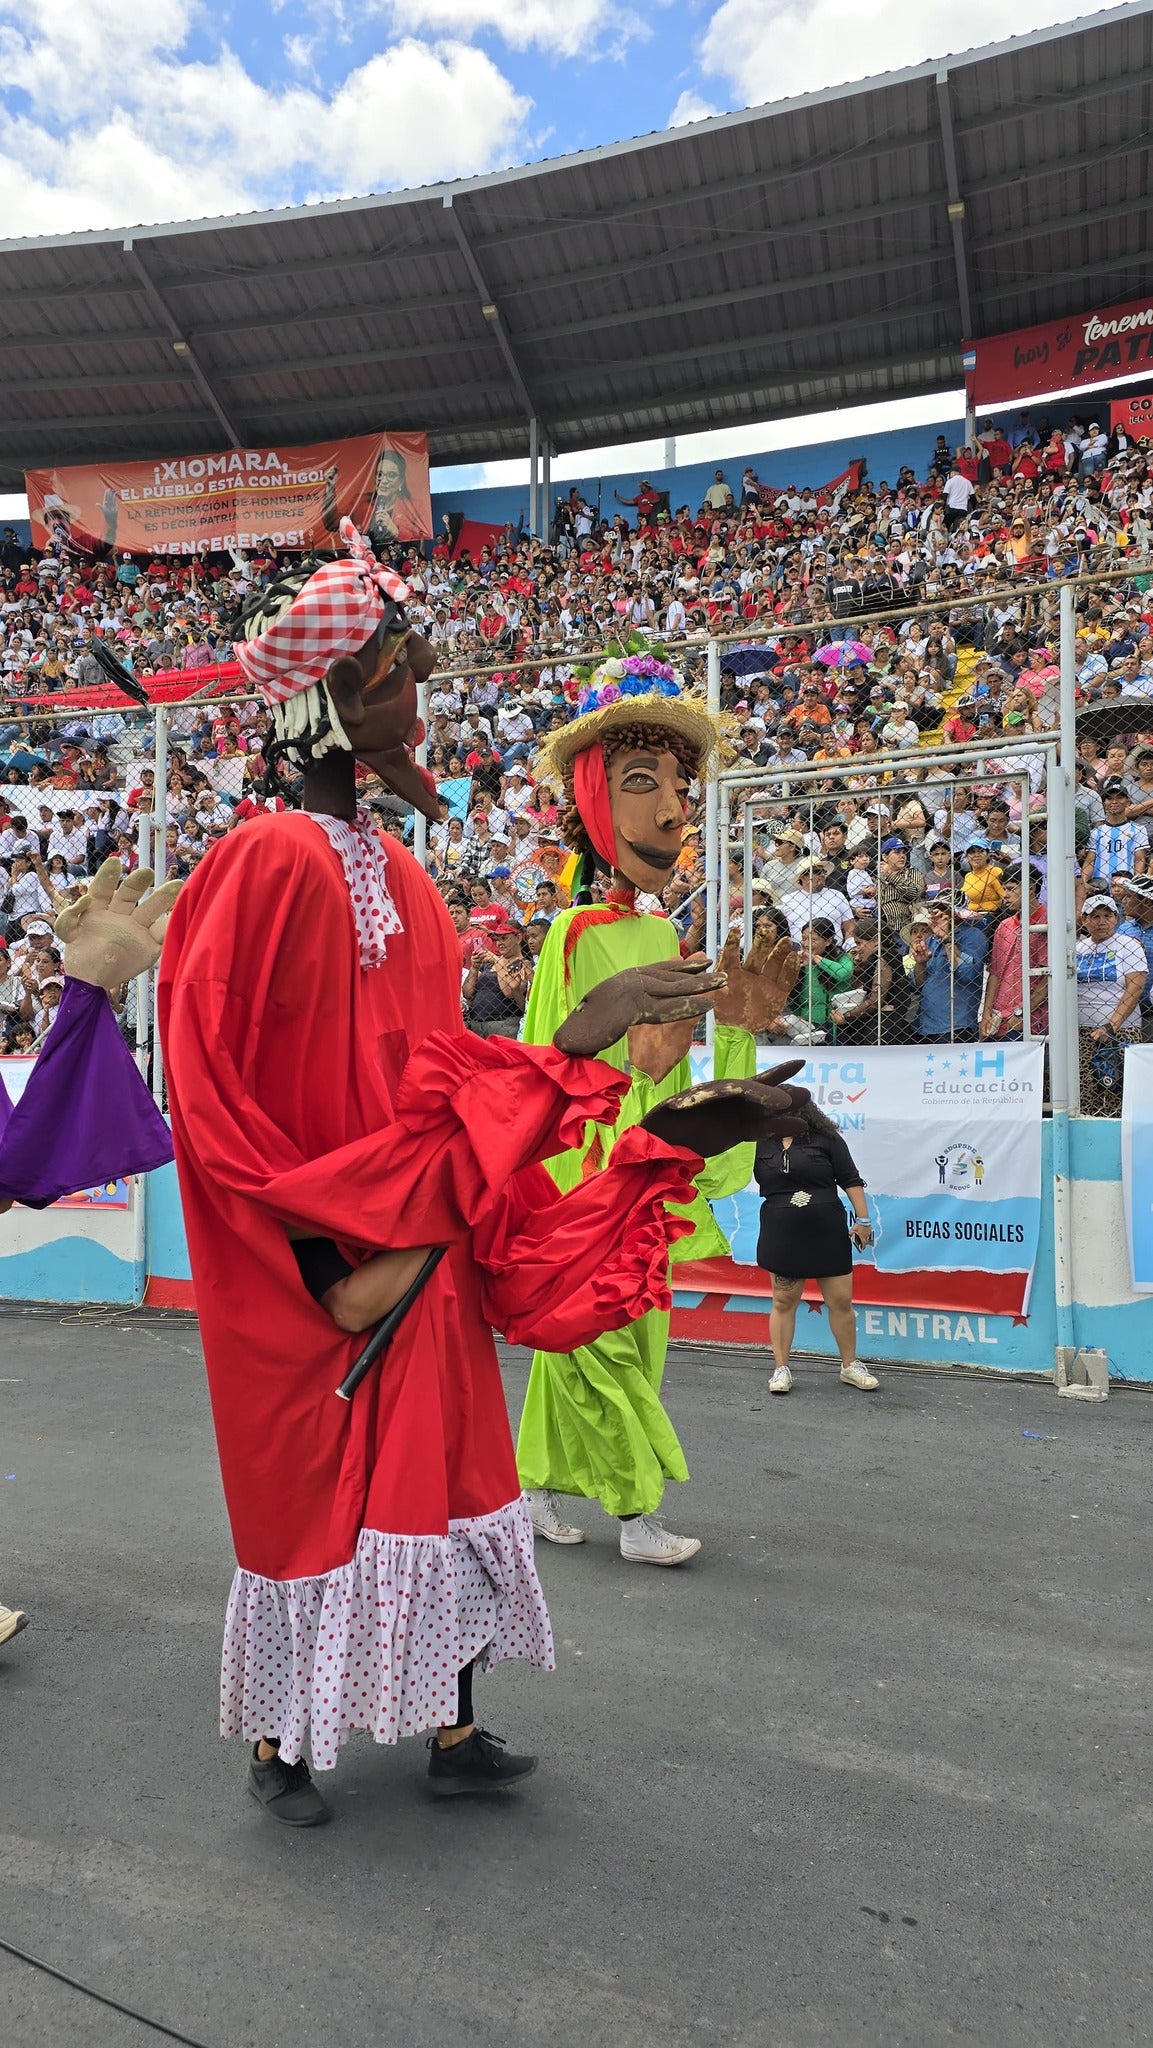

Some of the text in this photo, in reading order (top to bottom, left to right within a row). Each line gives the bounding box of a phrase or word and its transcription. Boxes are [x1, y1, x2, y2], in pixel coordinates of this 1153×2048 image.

[153, 452, 289, 485] ¡XIOMARA,
[120, 469, 325, 501] EL PUEBLO ESTÁ CONTIGO!
[127, 492, 320, 520] LA REFUNDACIÓN DE HONDURAS
[144, 508, 305, 532] ES DECIR PATRIA O MUERTE
[1107, 840, 1122, 853] 10
[974, 1050, 1005, 1078] H
[922, 1078, 1034, 1094] Educación
[921, 1097, 960, 1105] Gobierno
[960, 1097, 971, 1105] de
[972, 1097, 981, 1105] la
[906, 1220, 1025, 1243] BECAS SOCIALES
[855, 1310, 998, 1344] ENTRAL
